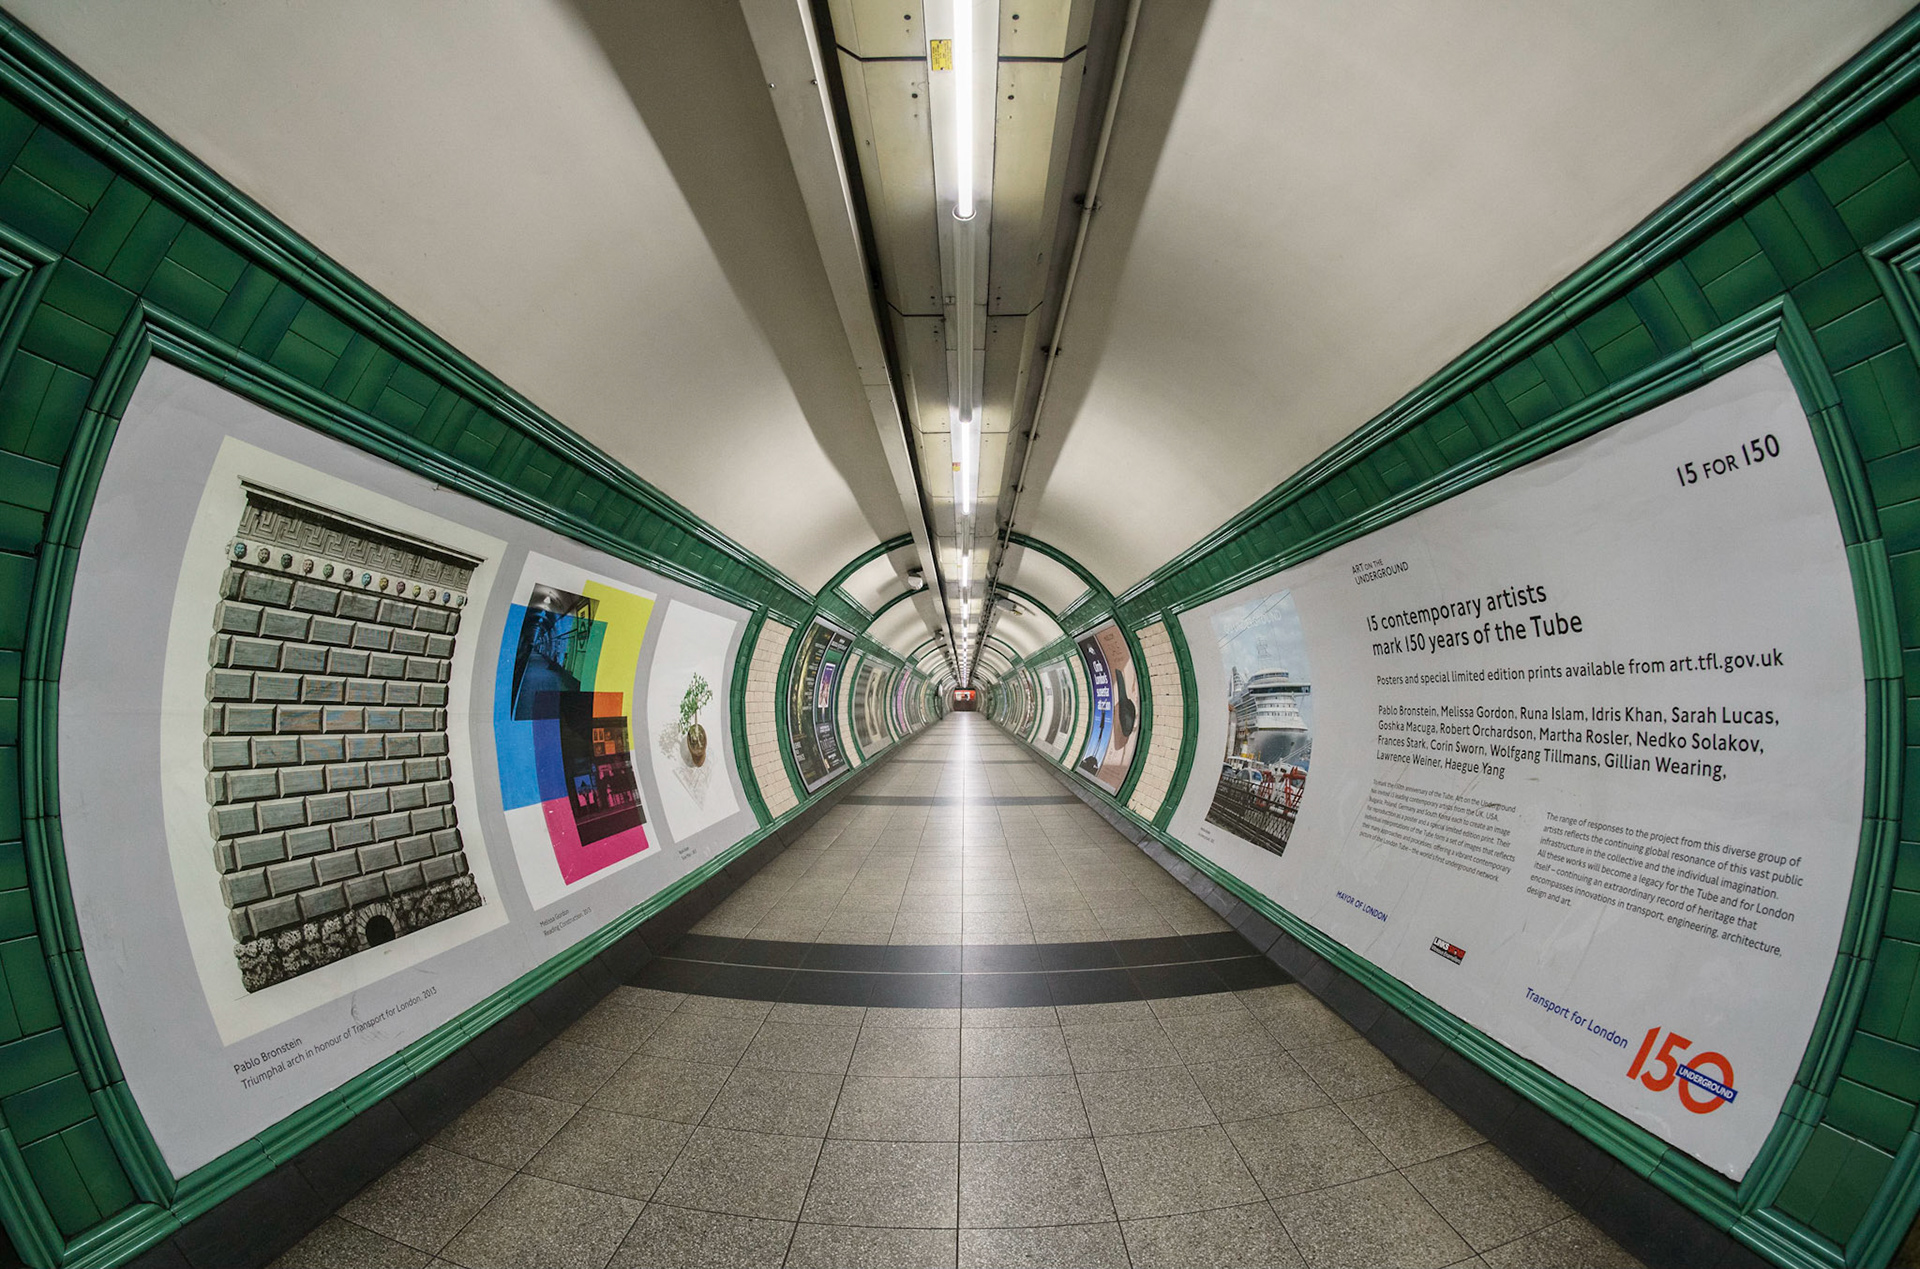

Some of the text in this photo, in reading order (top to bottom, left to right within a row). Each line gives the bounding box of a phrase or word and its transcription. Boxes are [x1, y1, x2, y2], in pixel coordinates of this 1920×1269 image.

[1676, 434, 1779, 486] 15 FOR 150
[1354, 561, 1408, 585] UNDERGROUND
[1366, 584, 1546, 631] 15 contemporary artists
[1372, 612, 1582, 655] mark 150 years of the Tube
[1376, 648, 1783, 685] Posters and special limited edition prints available from art.tfl.gov.uk
[1378, 705, 1779, 725] Pablo Bronstein, Melissa Gordon, Runa Islam, Idris Khan, Sarah Lucas,
[1378, 719, 1763, 754] Goshka Macuga, Robert Orchardson, Martha Rosler, Nedko Solakov,
[1376, 750, 1505, 779] Lawrence Weiner, Haegue Yang
[1378, 734, 1726, 781] Frances Stark, Corin Sworn, Wolfgang Tillmans, Gillian Wearing,
[1540, 837, 1584, 853] infrastructure
[1593, 849, 1606, 859] the
[1606, 853, 1643, 868] collective
[1644, 862, 1660, 871] and
[1661, 864, 1675, 875] the
[1676, 867, 1719, 885] individual
[1543, 826, 1803, 886] artists reflects the continuing global resonance of this vast public
[1547, 811, 1558, 821] The
[1558, 816, 1577, 826] range
[1587, 821, 1623, 834] responses
[1625, 827, 1634, 836] to
[1635, 829, 1648, 839] the
[1649, 832, 1679, 844] project
[1680, 836, 1702, 848] from
[1703, 841, 1720, 852] this
[1722, 844, 1756, 859] diverse
[1756, 852, 1787, 866] group
[1788, 856, 1802, 867] of
[1336, 890, 1388, 922] MAYOR OF LONDON
[1526, 885, 1546, 898] design
[1547, 893, 1560, 902] and
[1530, 874, 1573, 892] encompasses
[1574, 888, 1616, 906] innovations
[1533, 862, 1551, 871] itself
[1556, 868, 1592, 886] continuing
[1593, 878, 1602, 886] an
[1603, 881, 1656, 903] extraordinary
[1656, 896, 1685, 910] record
[1685, 903, 1697, 912] of
[1697, 905, 1735, 924] heritage
[1737, 916, 1758, 930] that
[1537, 849, 1546, 857] All
[1546, 852, 1564, 862] these
[1565, 857, 1586, 868] works
[1587, 863, 1600, 872] will
[1600, 864, 1631, 880] become
[1638, 874, 1664, 890] legacy
[1665, 880, 1679, 891] for
[1679, 884, 1694, 896] the
[1697, 887, 1718, 902] Tube
[1719, 896, 1738, 907] and
[1739, 898, 1754, 911] for
[1755, 902, 1794, 922] London
[240, 986, 437, 1089] Triumphal arch in honour of Transport for London, 2013
[1525, 987, 1628, 1048] Transport for London
[233, 1038, 302, 1074] Pablo Bronstein
[1626, 1026, 1734, 1114] 150
[1679, 1066, 1734, 1099] UNDERGROUND
